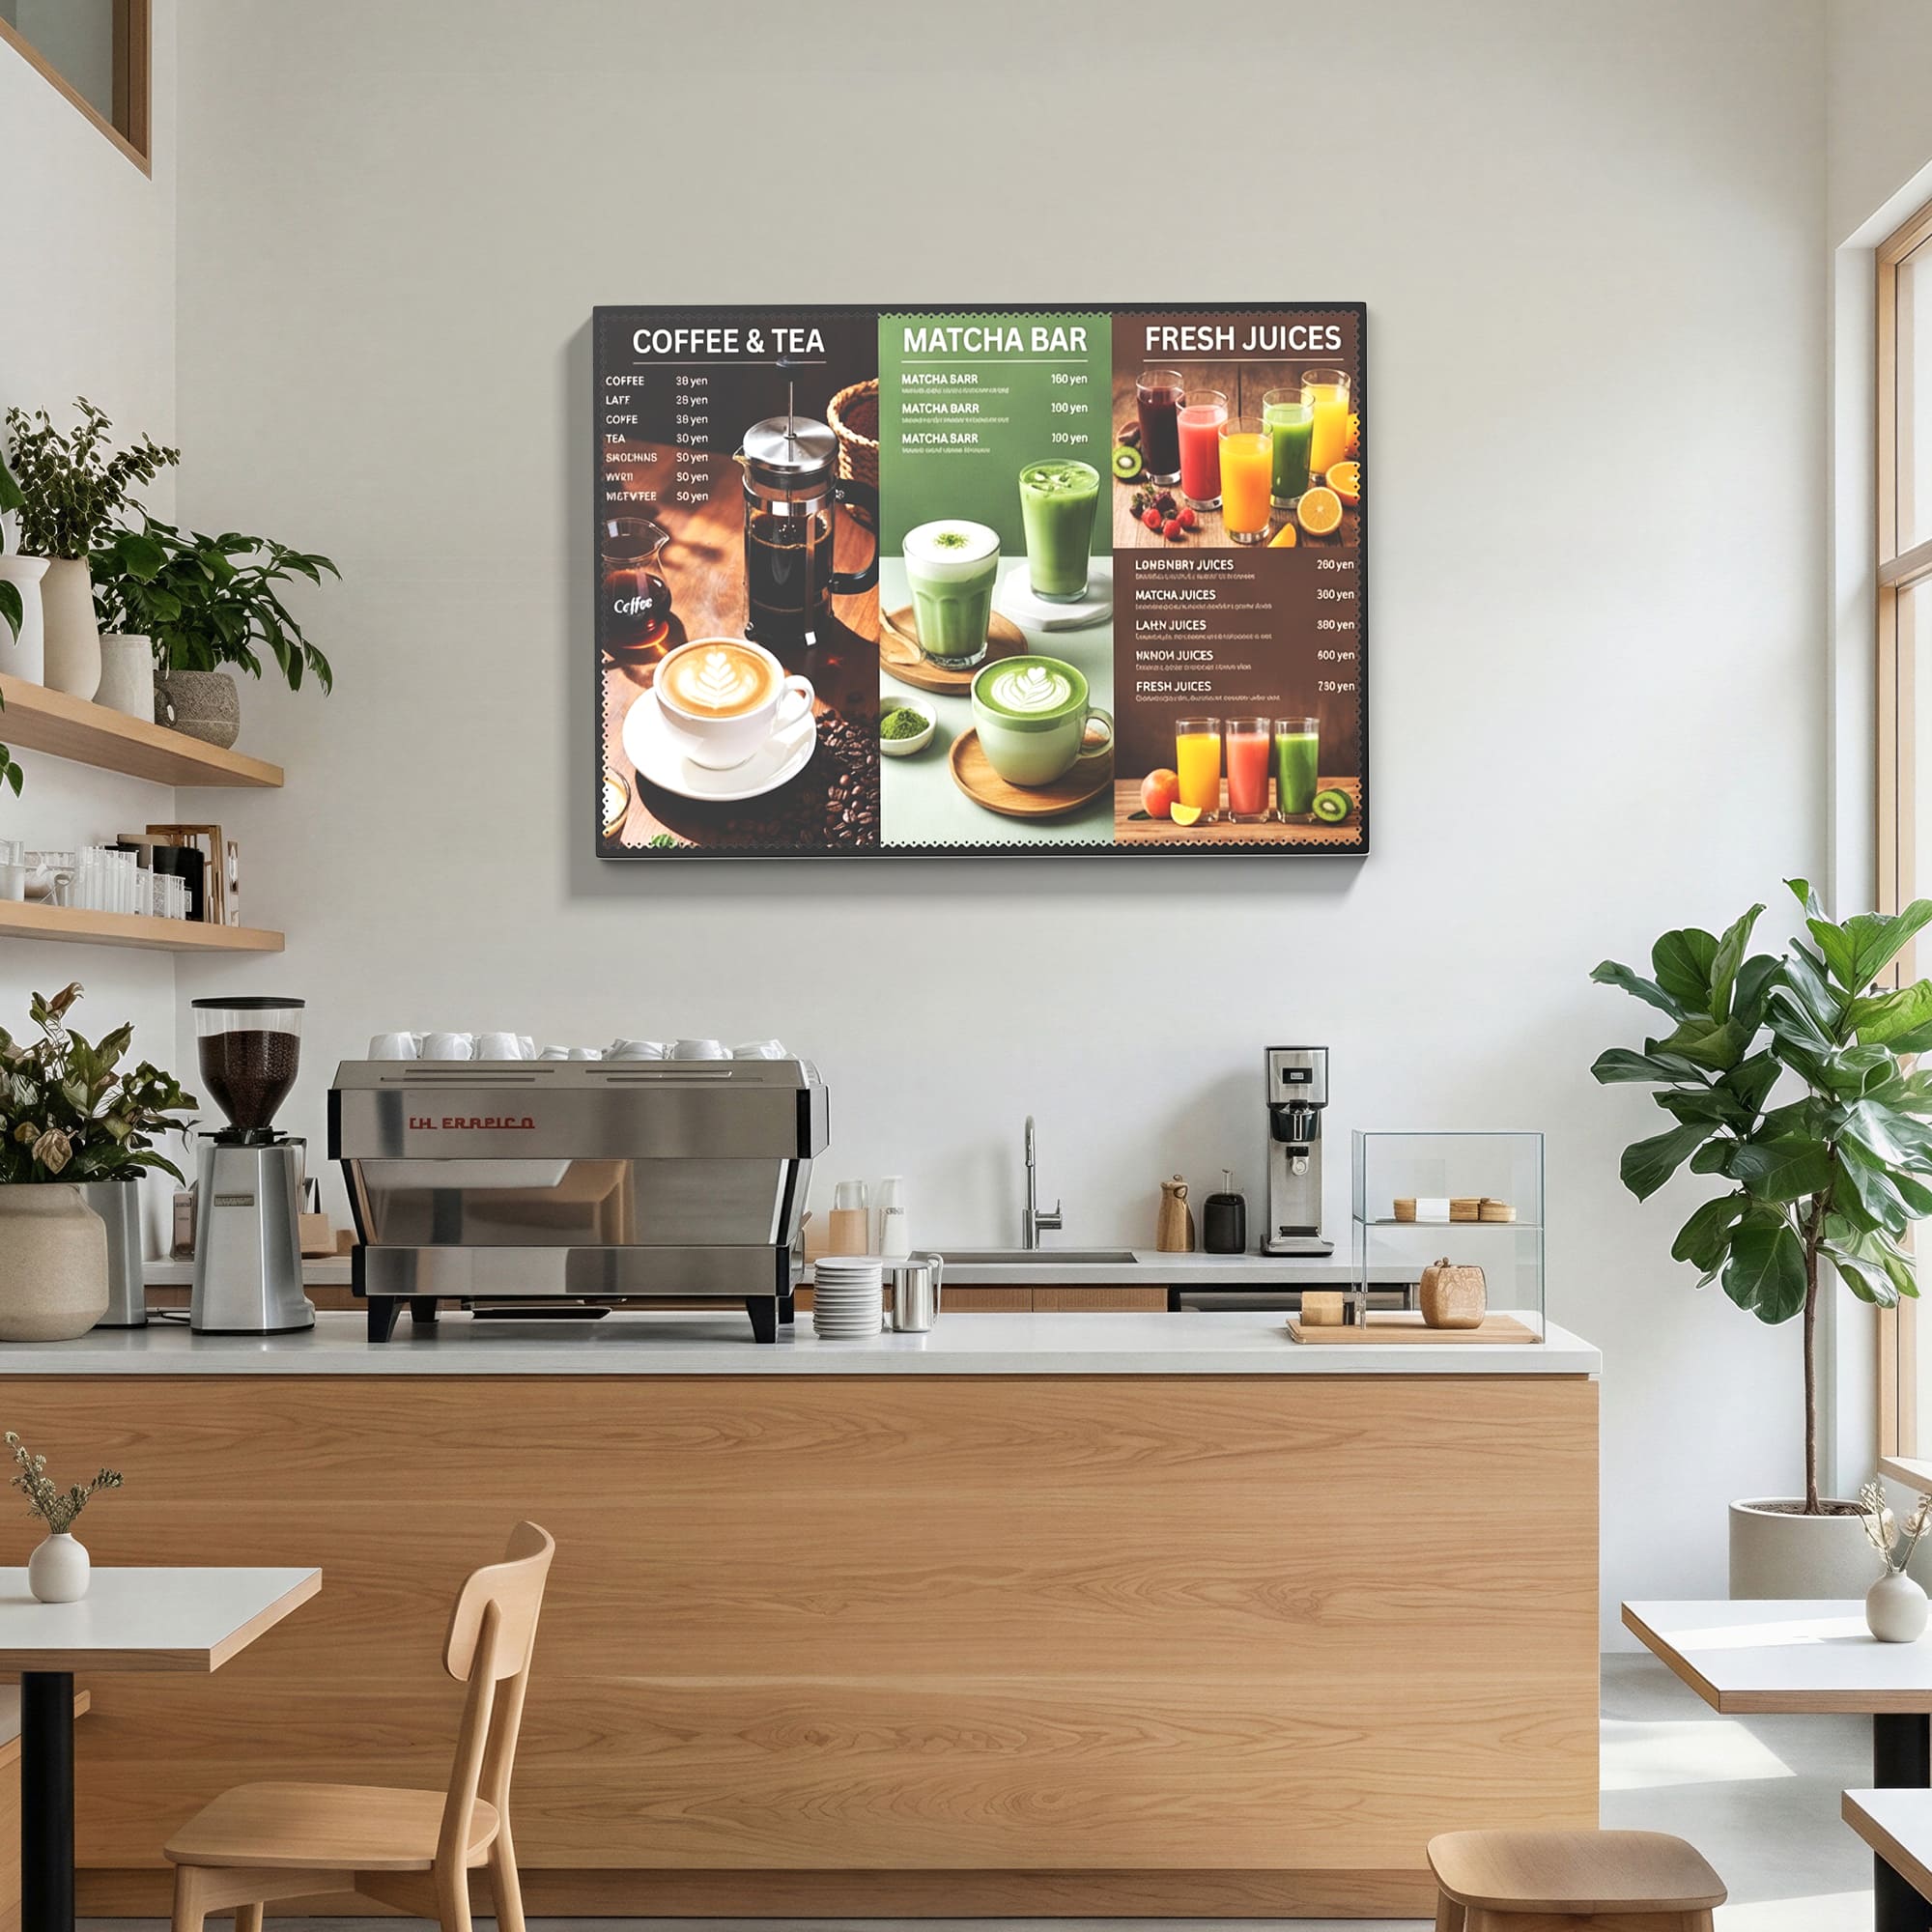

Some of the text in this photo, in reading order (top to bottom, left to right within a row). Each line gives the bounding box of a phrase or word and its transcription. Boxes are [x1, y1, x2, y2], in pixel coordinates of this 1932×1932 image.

[633, 328, 825, 354] COFFEE & TEA
[903, 327, 1088, 353] MATCHA BAR
[1146, 326, 1342, 351] FRESH JUICES
[606, 376, 645, 386] COFFEE
[690, 378, 708, 388] yen
[902, 374, 949, 384] MATCHA
[1069, 375, 1088, 386] yen
[690, 397, 708, 407] yen
[902, 404, 949, 414] MATCHA
[1051, 402, 1089, 415] 100 yen
[690, 416, 708, 427] yen
[605, 434, 626, 443] TEA
[690, 435, 708, 445] yen
[902, 434, 949, 444] MATCHA
[1069, 434, 1089, 445] yen
[690, 454, 708, 465] yen
[690, 473, 709, 484] yen
[690, 493, 709, 503] yen
[1196, 559, 1235, 571] JUICES
[1336, 561, 1354, 573] yen
[1135, 589, 1217, 601] MATCHA JUICES
[1336, 591, 1354, 602] yen
[1168, 620, 1208, 631] JUICES
[1336, 621, 1355, 633] yen
[1176, 650, 1214, 661] JUICES
[1336, 652, 1355, 663] yen
[1136, 680, 1212, 692] FRESH JUICES
[1336, 683, 1355, 694] yen
